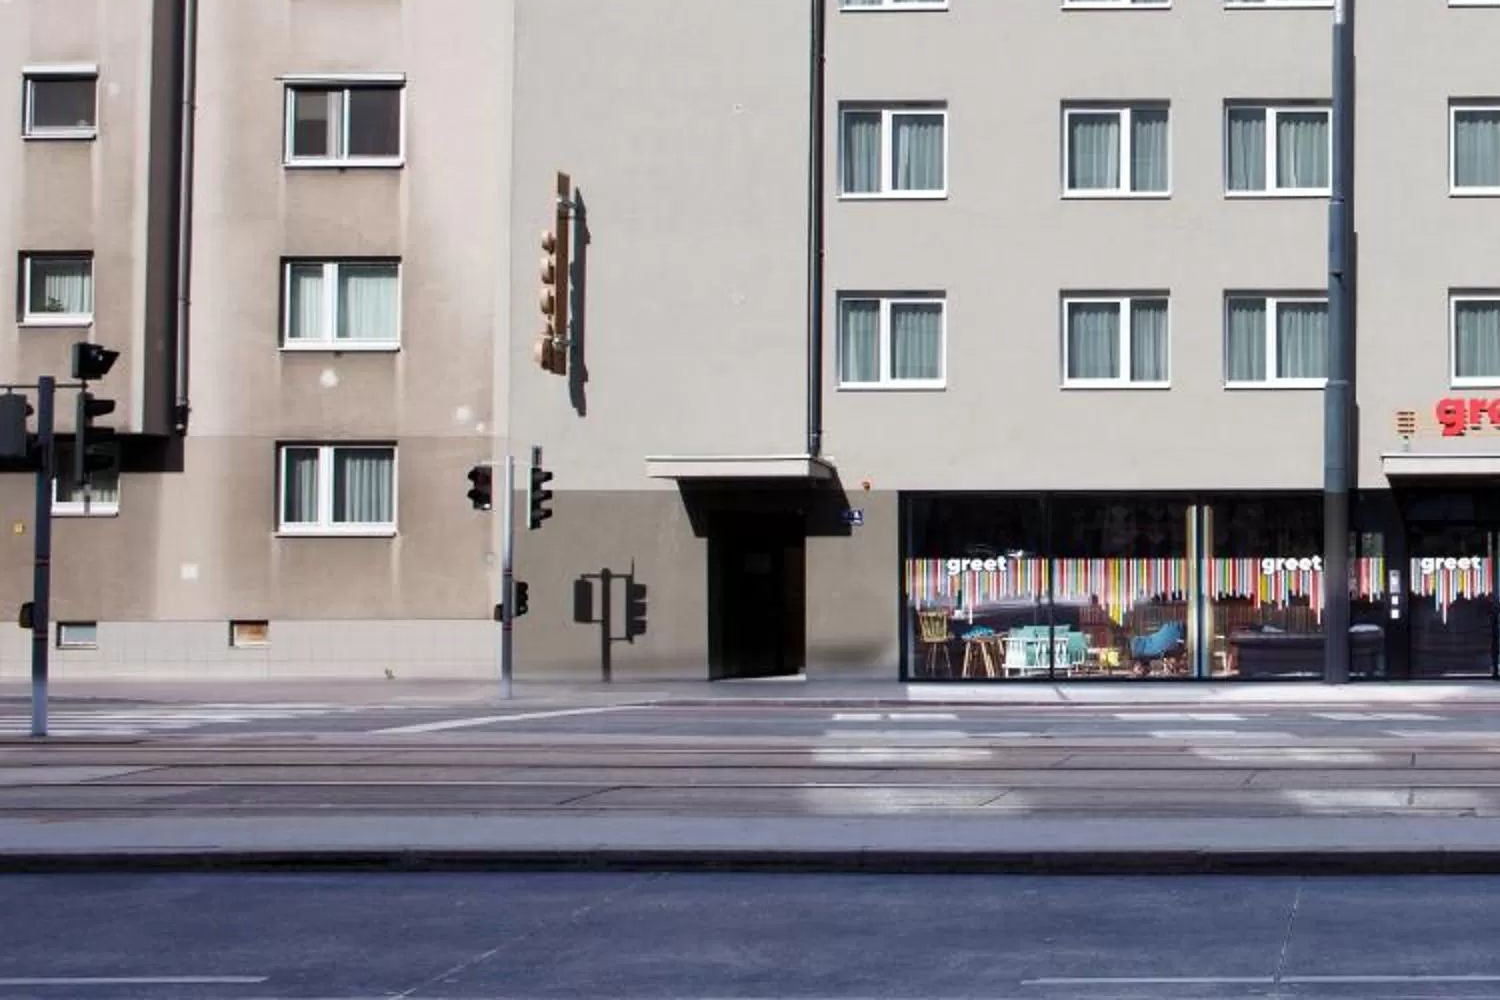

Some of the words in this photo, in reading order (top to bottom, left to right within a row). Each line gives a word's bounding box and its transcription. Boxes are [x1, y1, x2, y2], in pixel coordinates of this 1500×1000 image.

[947, 555, 1007, 576] greet
[1261, 555, 1322, 575] greet
[1421, 556, 1481, 575] greet
